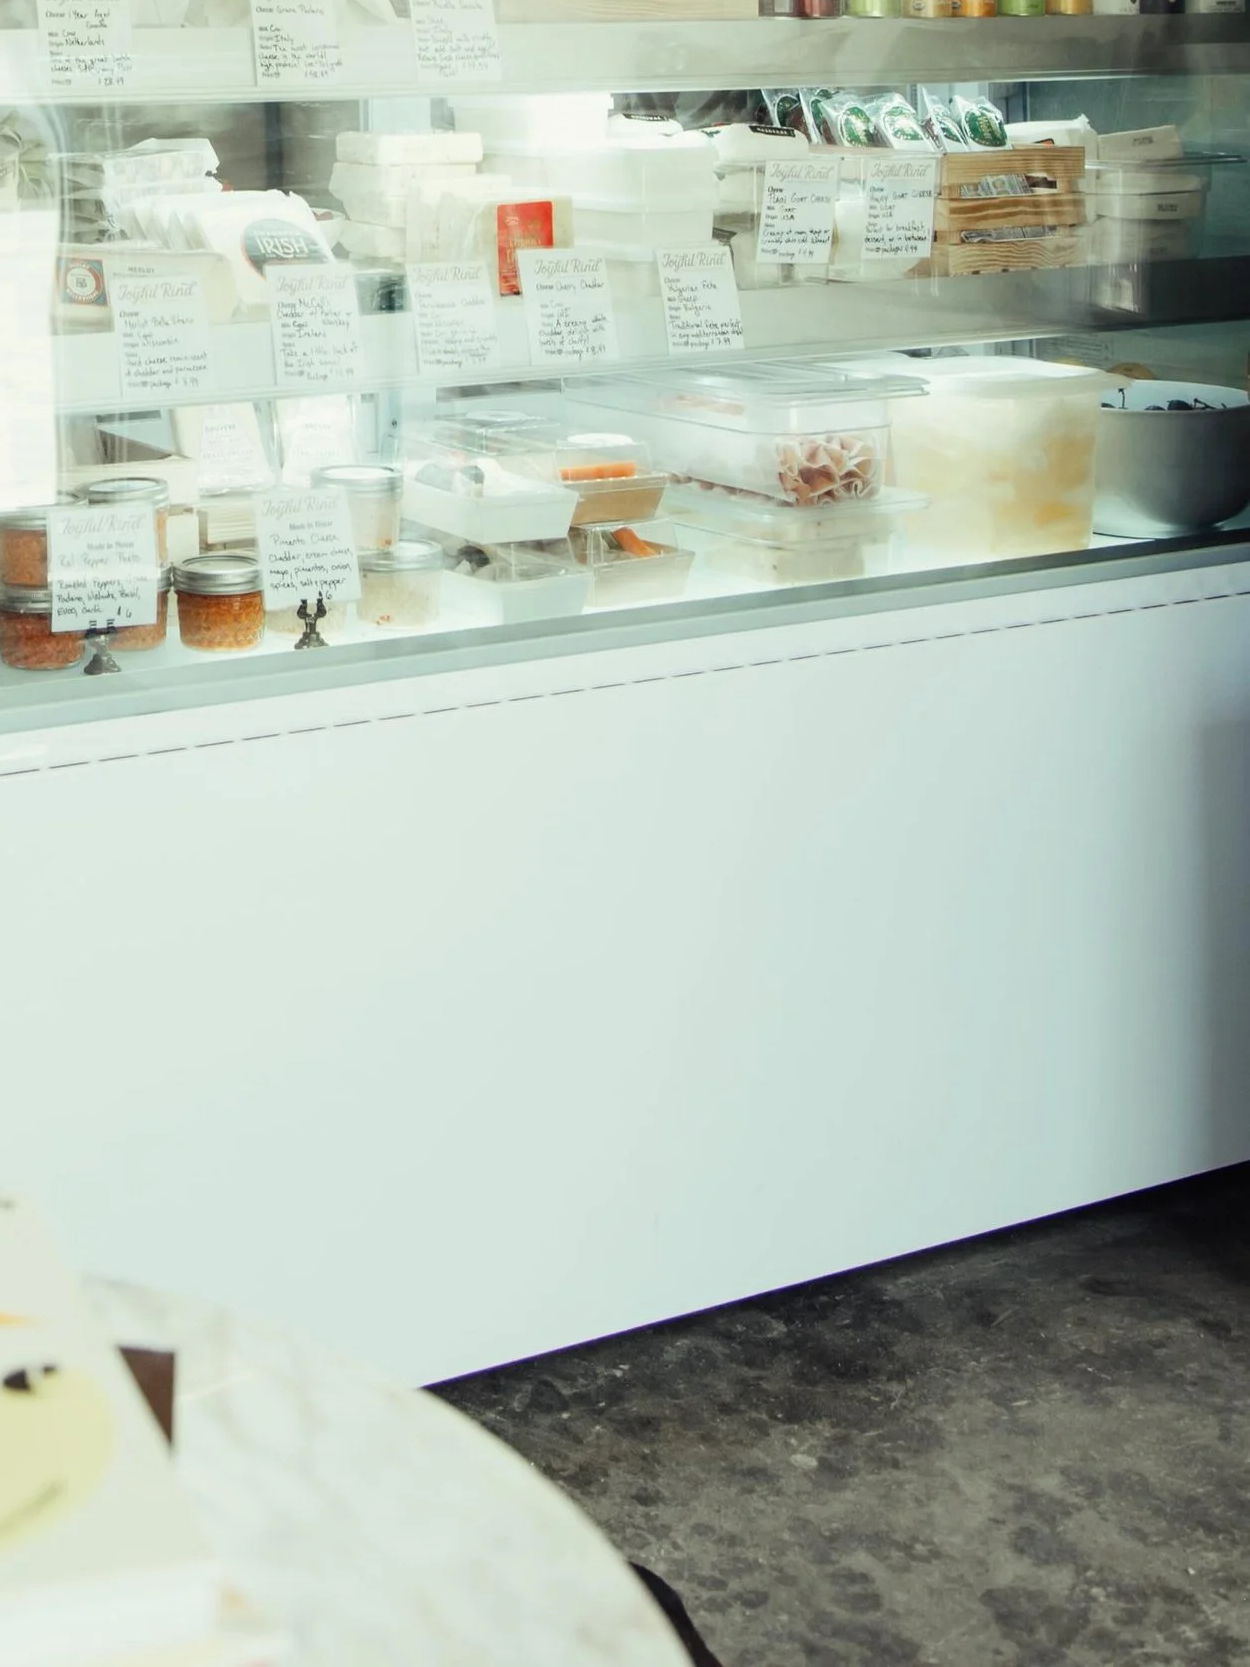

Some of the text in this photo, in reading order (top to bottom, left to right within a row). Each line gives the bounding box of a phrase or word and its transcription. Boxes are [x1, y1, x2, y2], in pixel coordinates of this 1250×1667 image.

[66, 34, 105, 46] Netherlands
[273, 34, 294, 45] Italy
[256, 236, 310, 258] IRISH
[669, 286, 698, 296] Bulgarian
[670, 320, 703, 329] Traditional
[270, 534, 306, 546] Pimento
[270, 581, 298, 591] spices,
[319, 577, 346, 590] pepper
